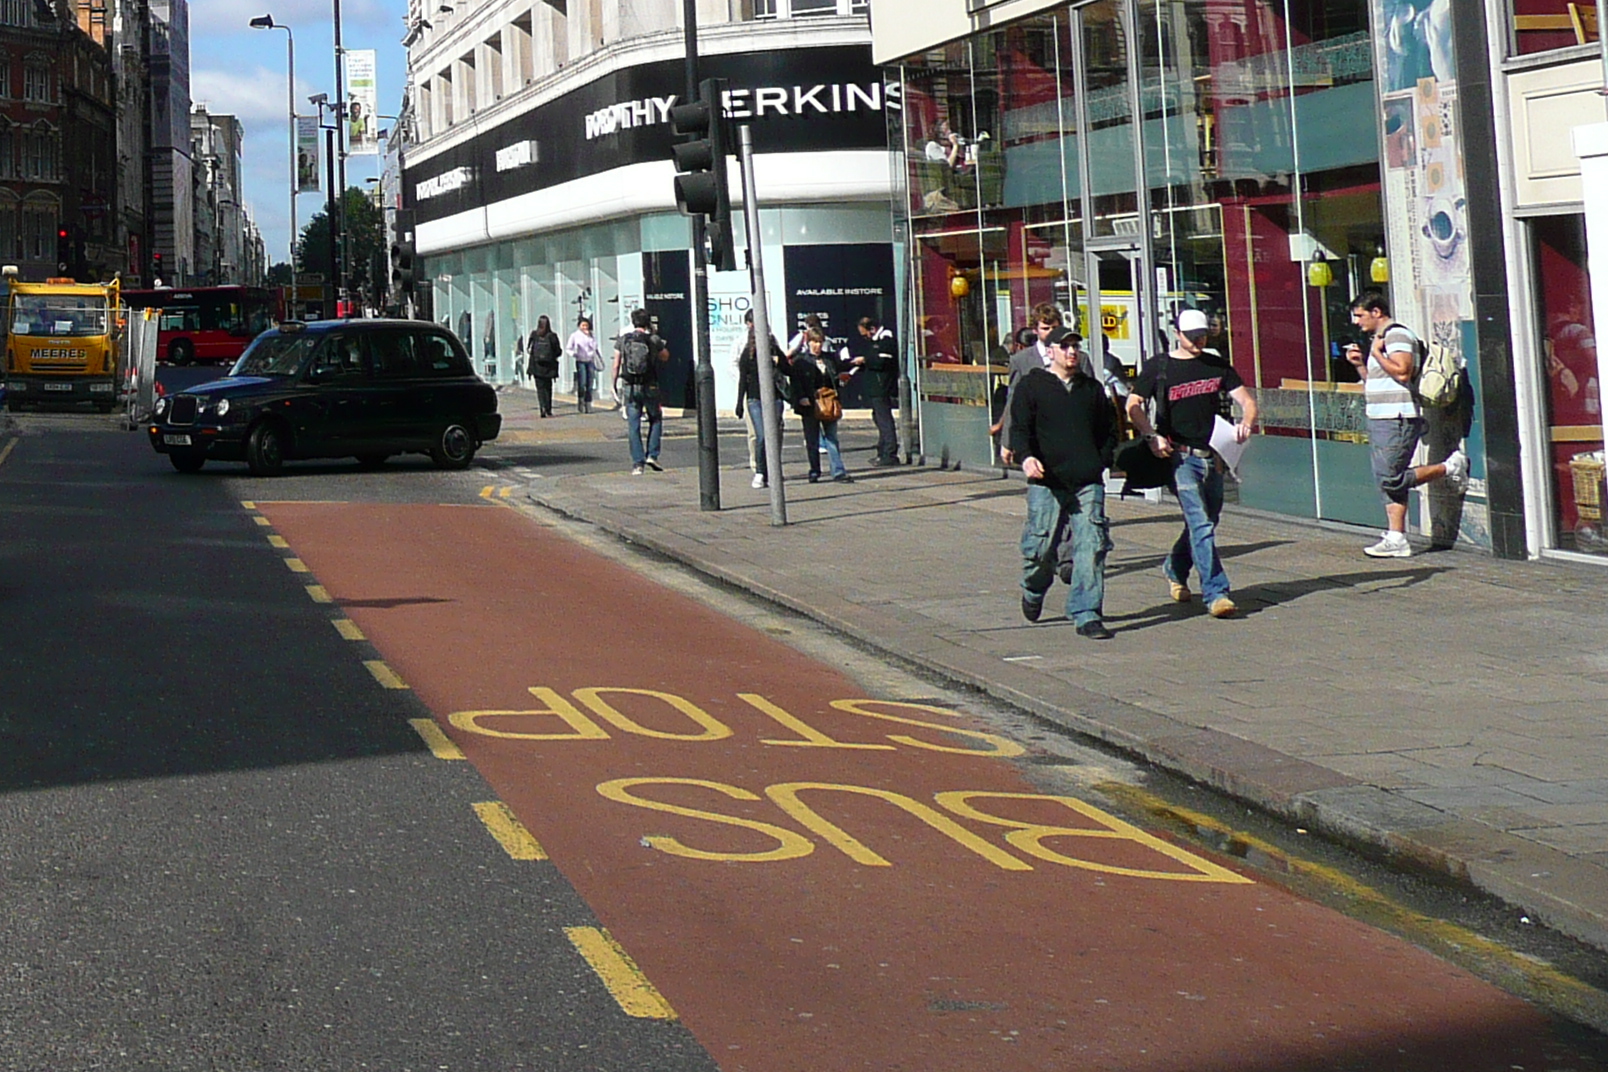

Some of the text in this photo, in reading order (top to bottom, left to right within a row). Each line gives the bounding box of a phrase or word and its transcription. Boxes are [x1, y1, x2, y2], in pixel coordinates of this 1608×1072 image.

[721, 82, 901, 118] ERKINS
[708, 297, 750, 311] SHO
[31, 349, 87, 359] MEERES
[447, 686, 1026, 758] STOP
[596, 776, 1256, 885] BUS
